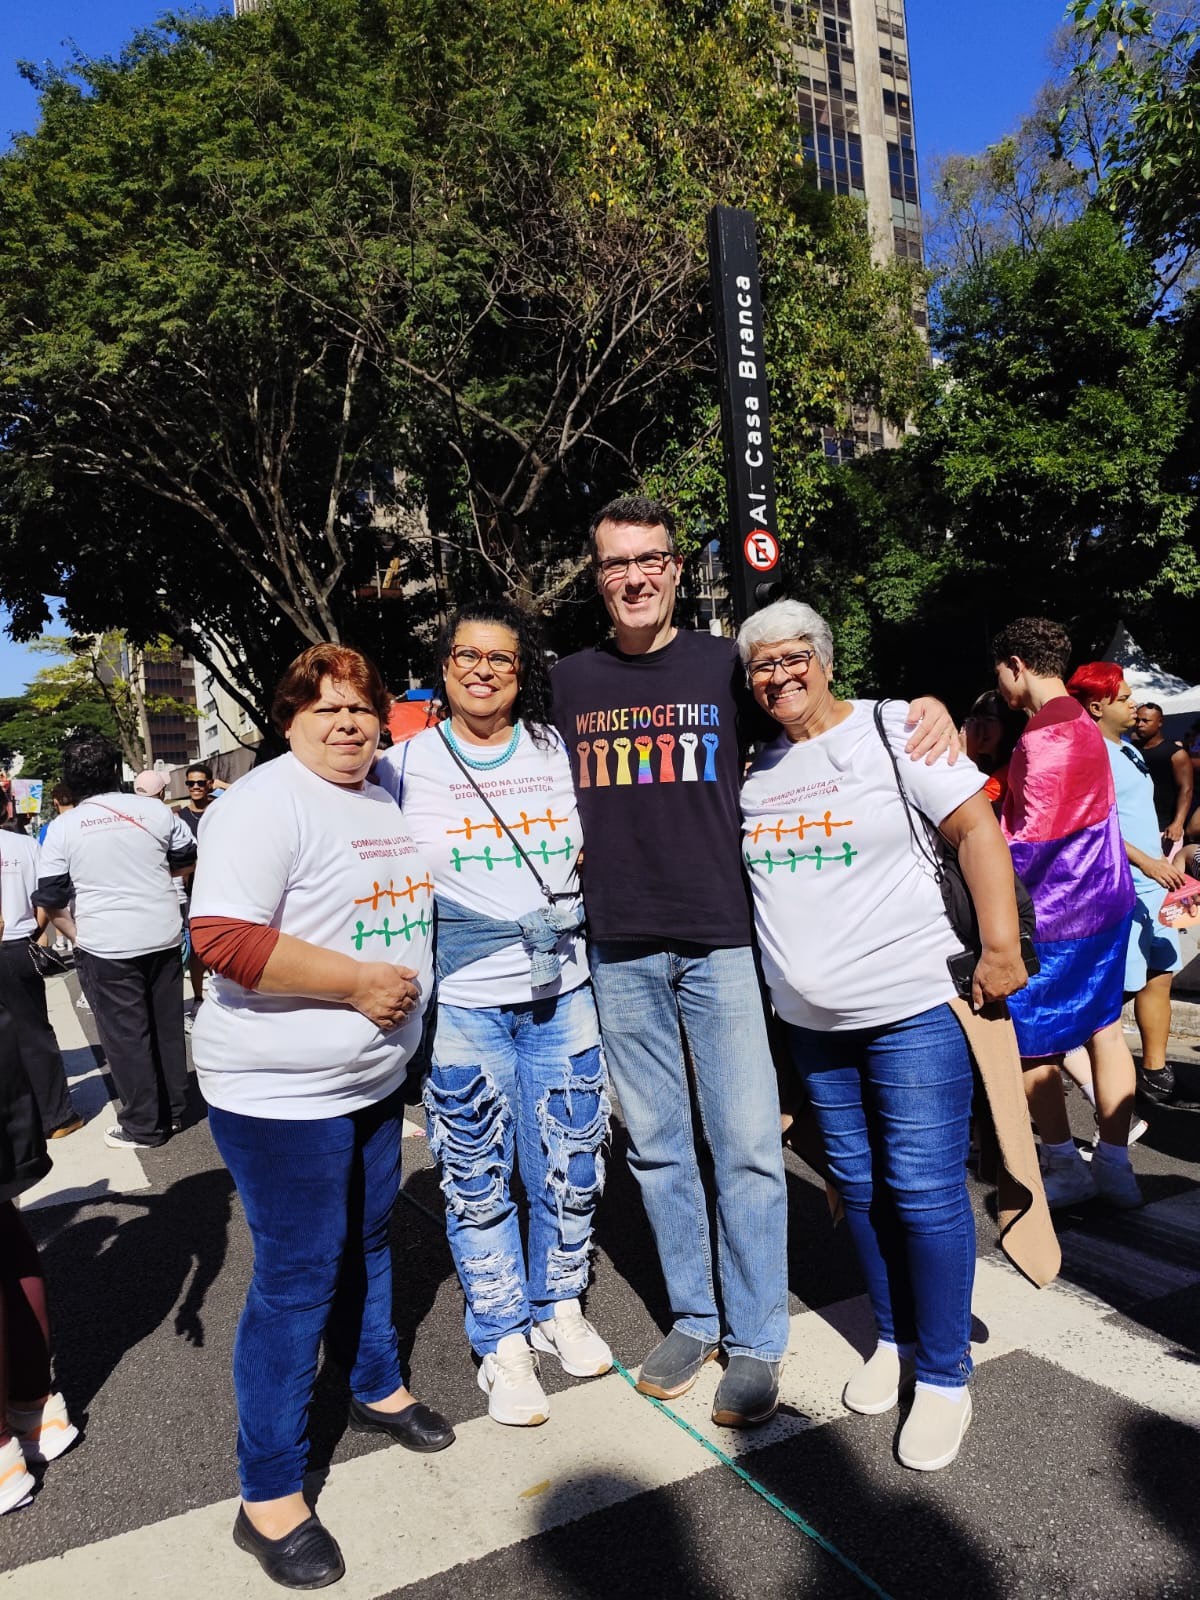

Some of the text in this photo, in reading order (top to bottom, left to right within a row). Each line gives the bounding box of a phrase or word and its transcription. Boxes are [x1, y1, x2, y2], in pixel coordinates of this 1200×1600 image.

[736, 275, 768, 526] Al. Casa Branca
[498, 779, 512, 787] NA
[513, 776, 535, 785] LUTA
[536, 775, 554, 783] POR
[807, 781, 826, 791] LUTA
[455, 784, 554, 800] DIGNDADE E JUSTIÇA
[80, 816, 113, 829] Abraça
[399, 845, 419, 856] JUSTI
